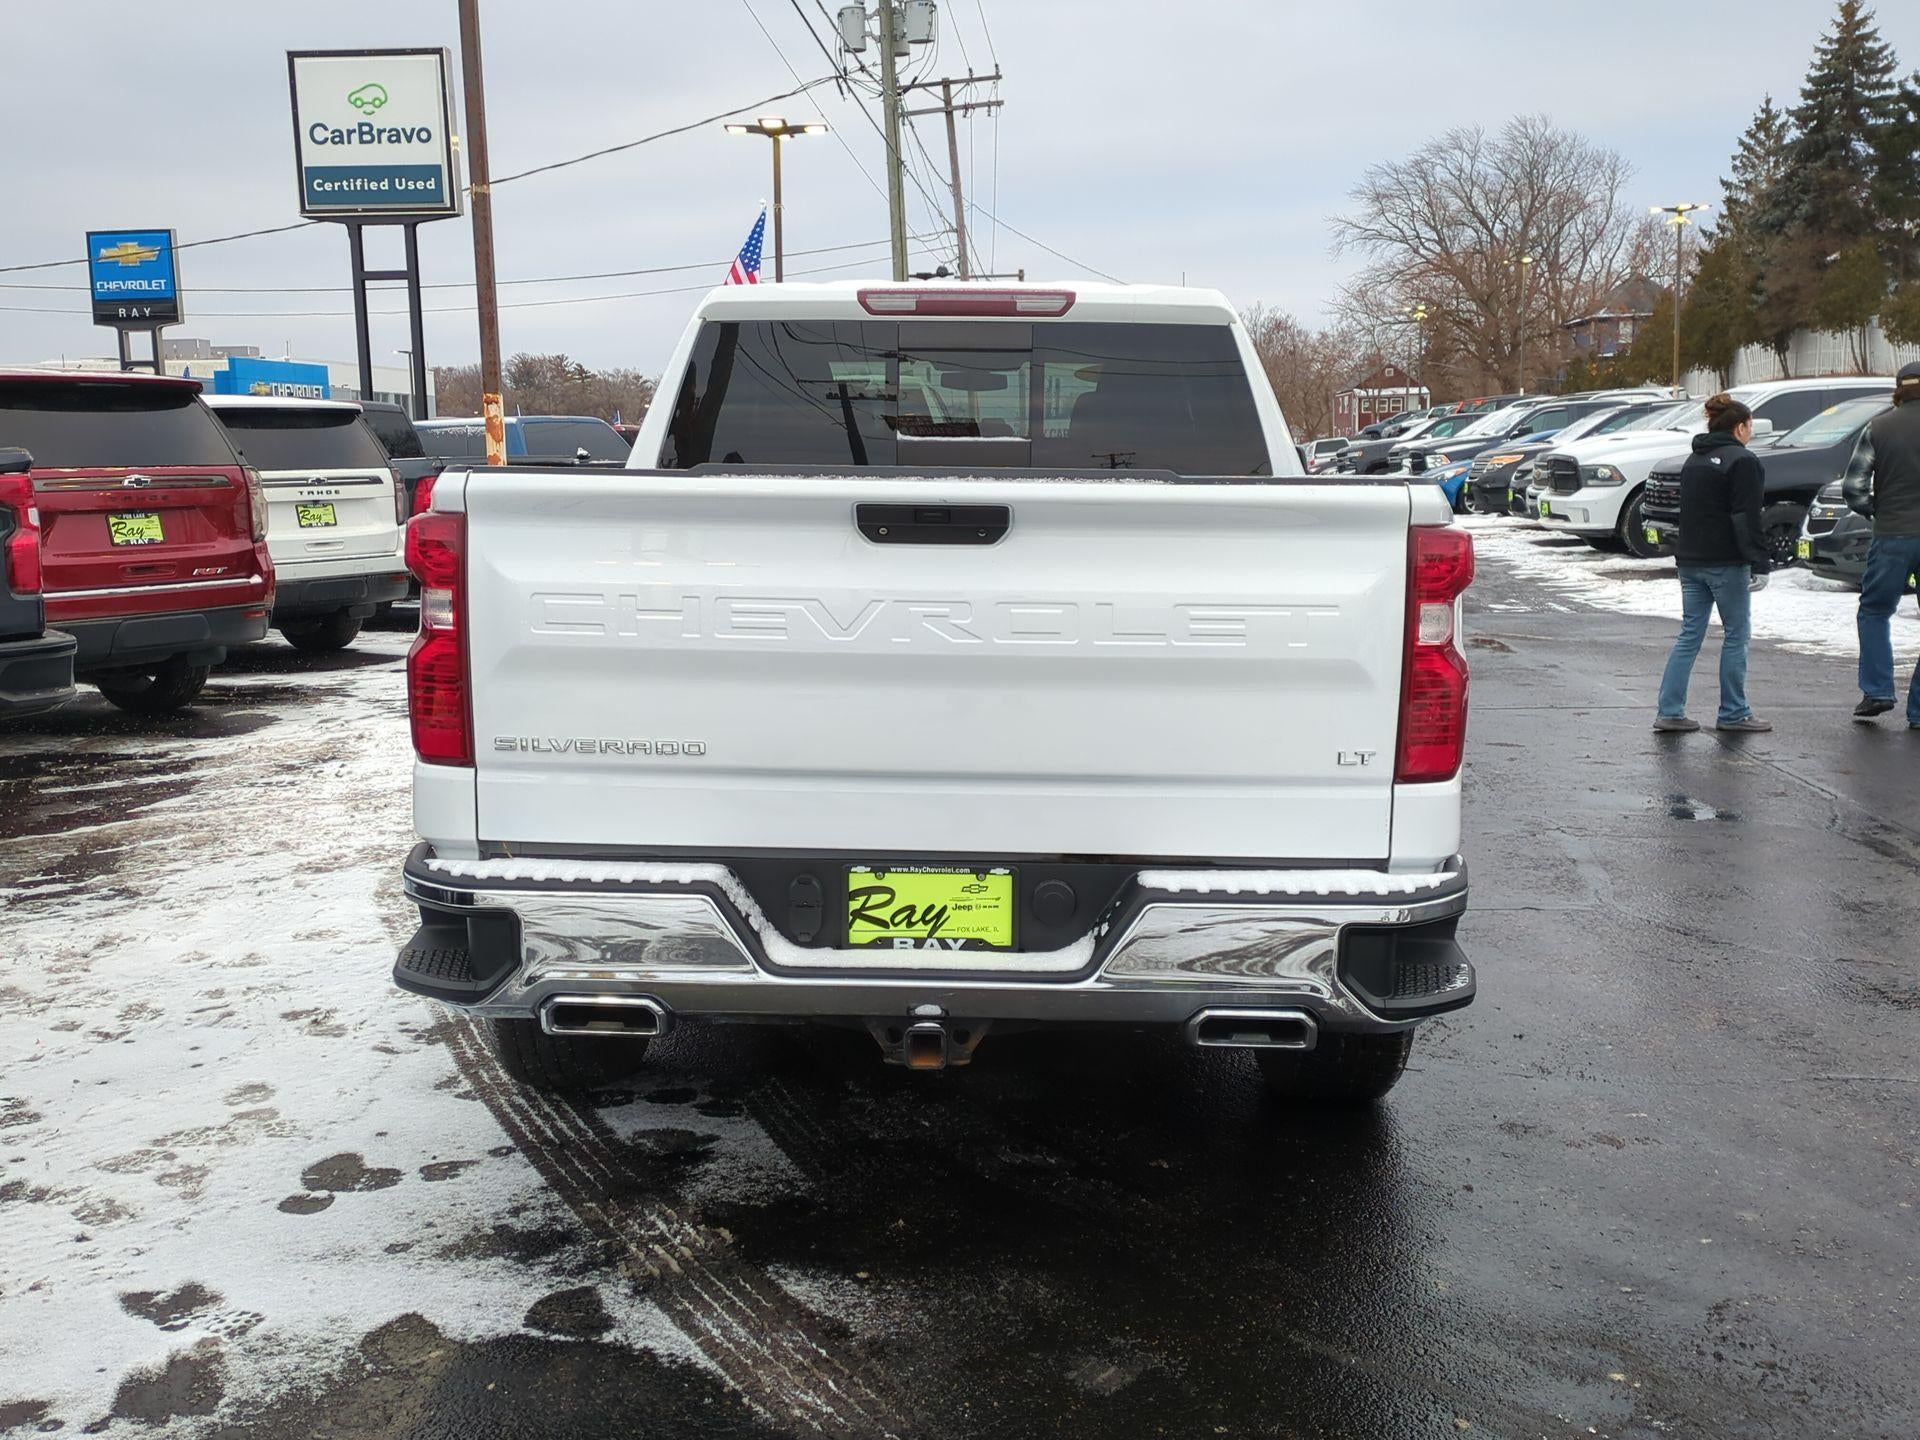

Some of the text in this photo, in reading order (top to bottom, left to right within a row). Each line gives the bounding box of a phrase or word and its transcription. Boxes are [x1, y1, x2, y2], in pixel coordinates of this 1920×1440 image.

[308, 121, 433, 146] CarBravo
[312, 177, 436, 191] Certified Used
[96, 279, 167, 292] CHEVROLET
[118, 307, 151, 318] RAY
[272, 381, 324, 400] CHEVROLET
[299, 509, 322, 523] Ray
[112, 521, 146, 539] Ray
[529, 591, 1340, 648] CHEVROLET
[494, 735, 708, 757] SILVERADO
[1337, 750, 1377, 766] LT
[890, 866, 971, 874] www.RayChevrolet.com
[849, 885, 951, 938] Ray
[951, 903, 973, 912] Jeep
[893, 938, 967, 950] RAY
